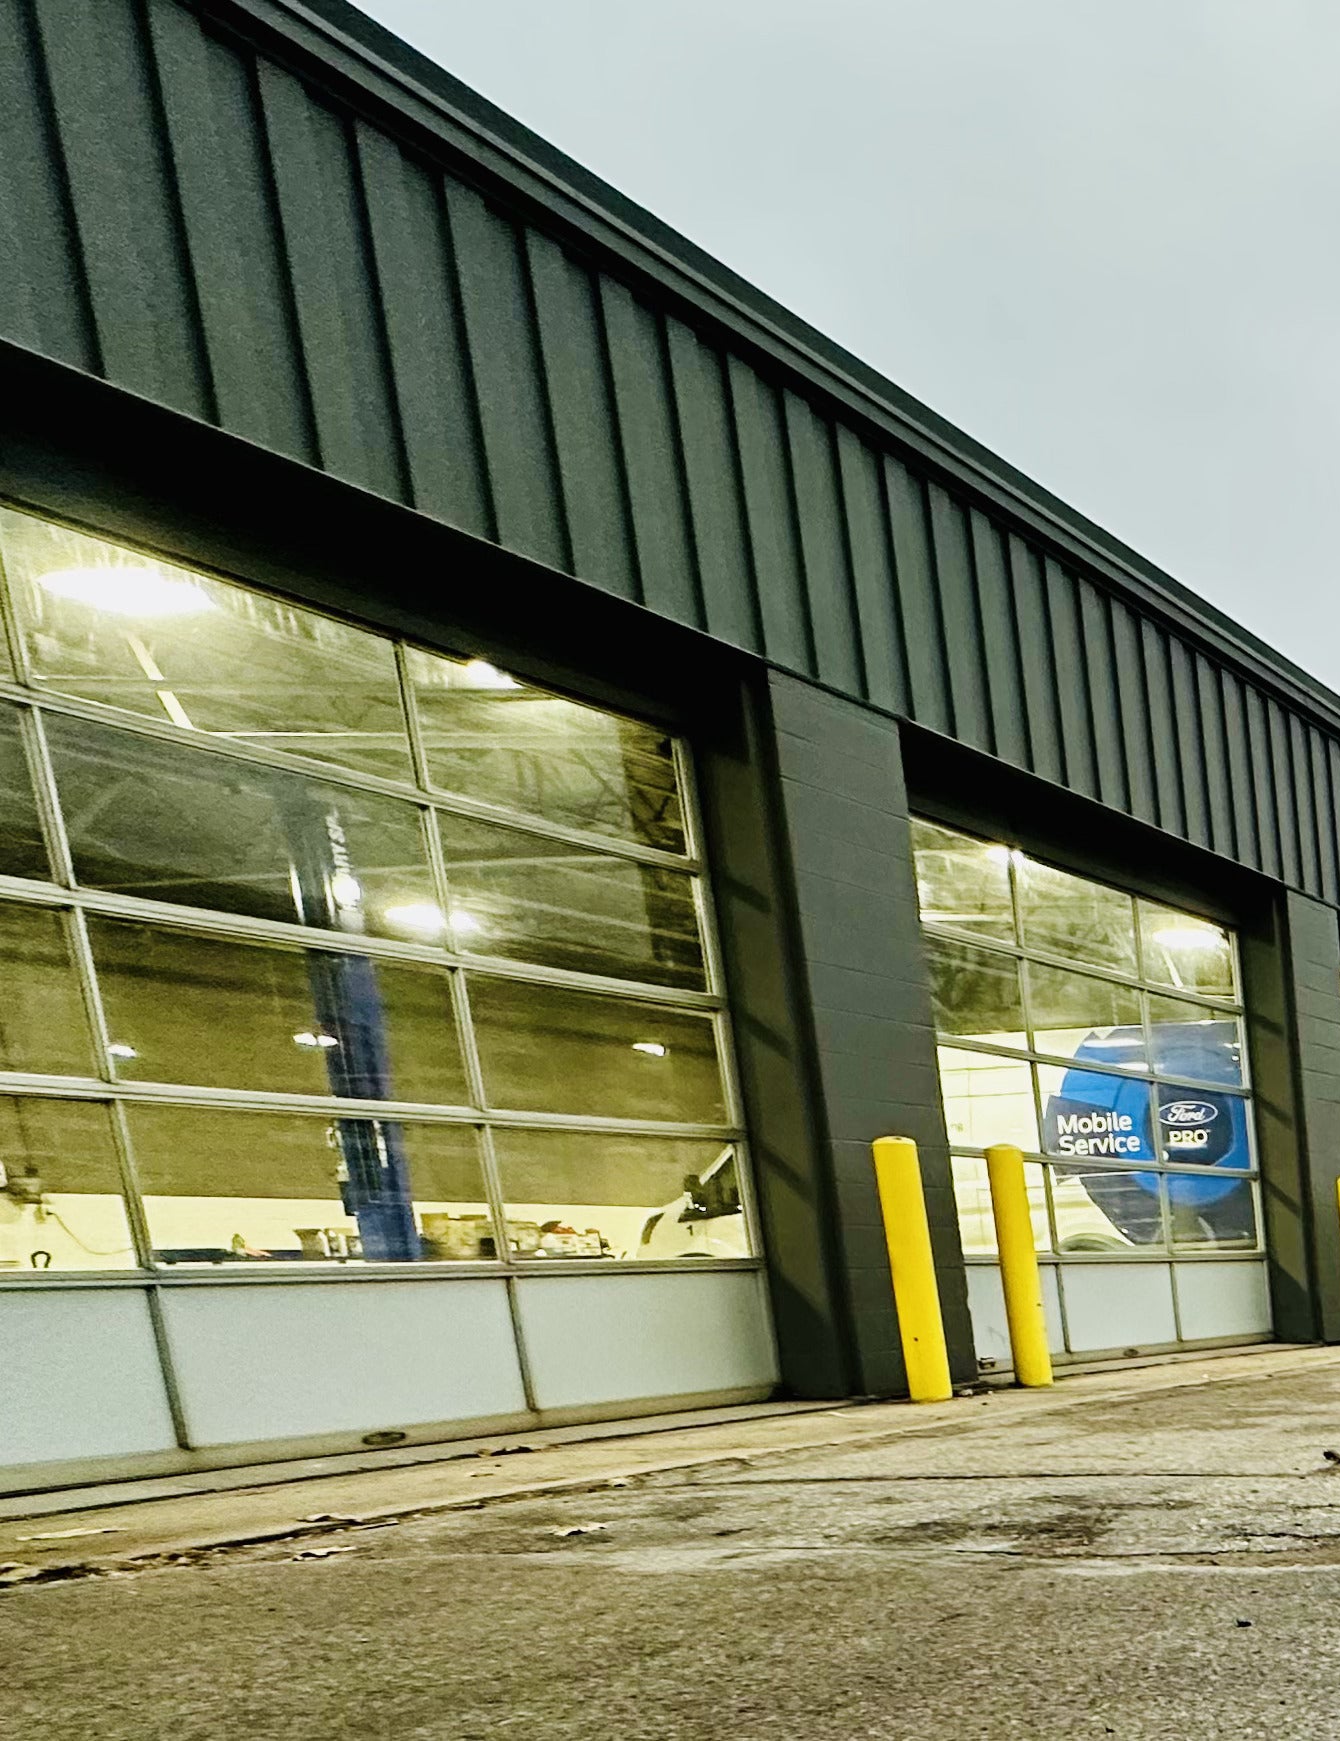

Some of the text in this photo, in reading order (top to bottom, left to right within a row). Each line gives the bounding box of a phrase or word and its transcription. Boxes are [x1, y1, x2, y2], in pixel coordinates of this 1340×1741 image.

[1056, 1111, 1133, 1135] Mobile
[1058, 1133, 1141, 1157] Service
[1168, 1129, 1209, 1145] PRO
